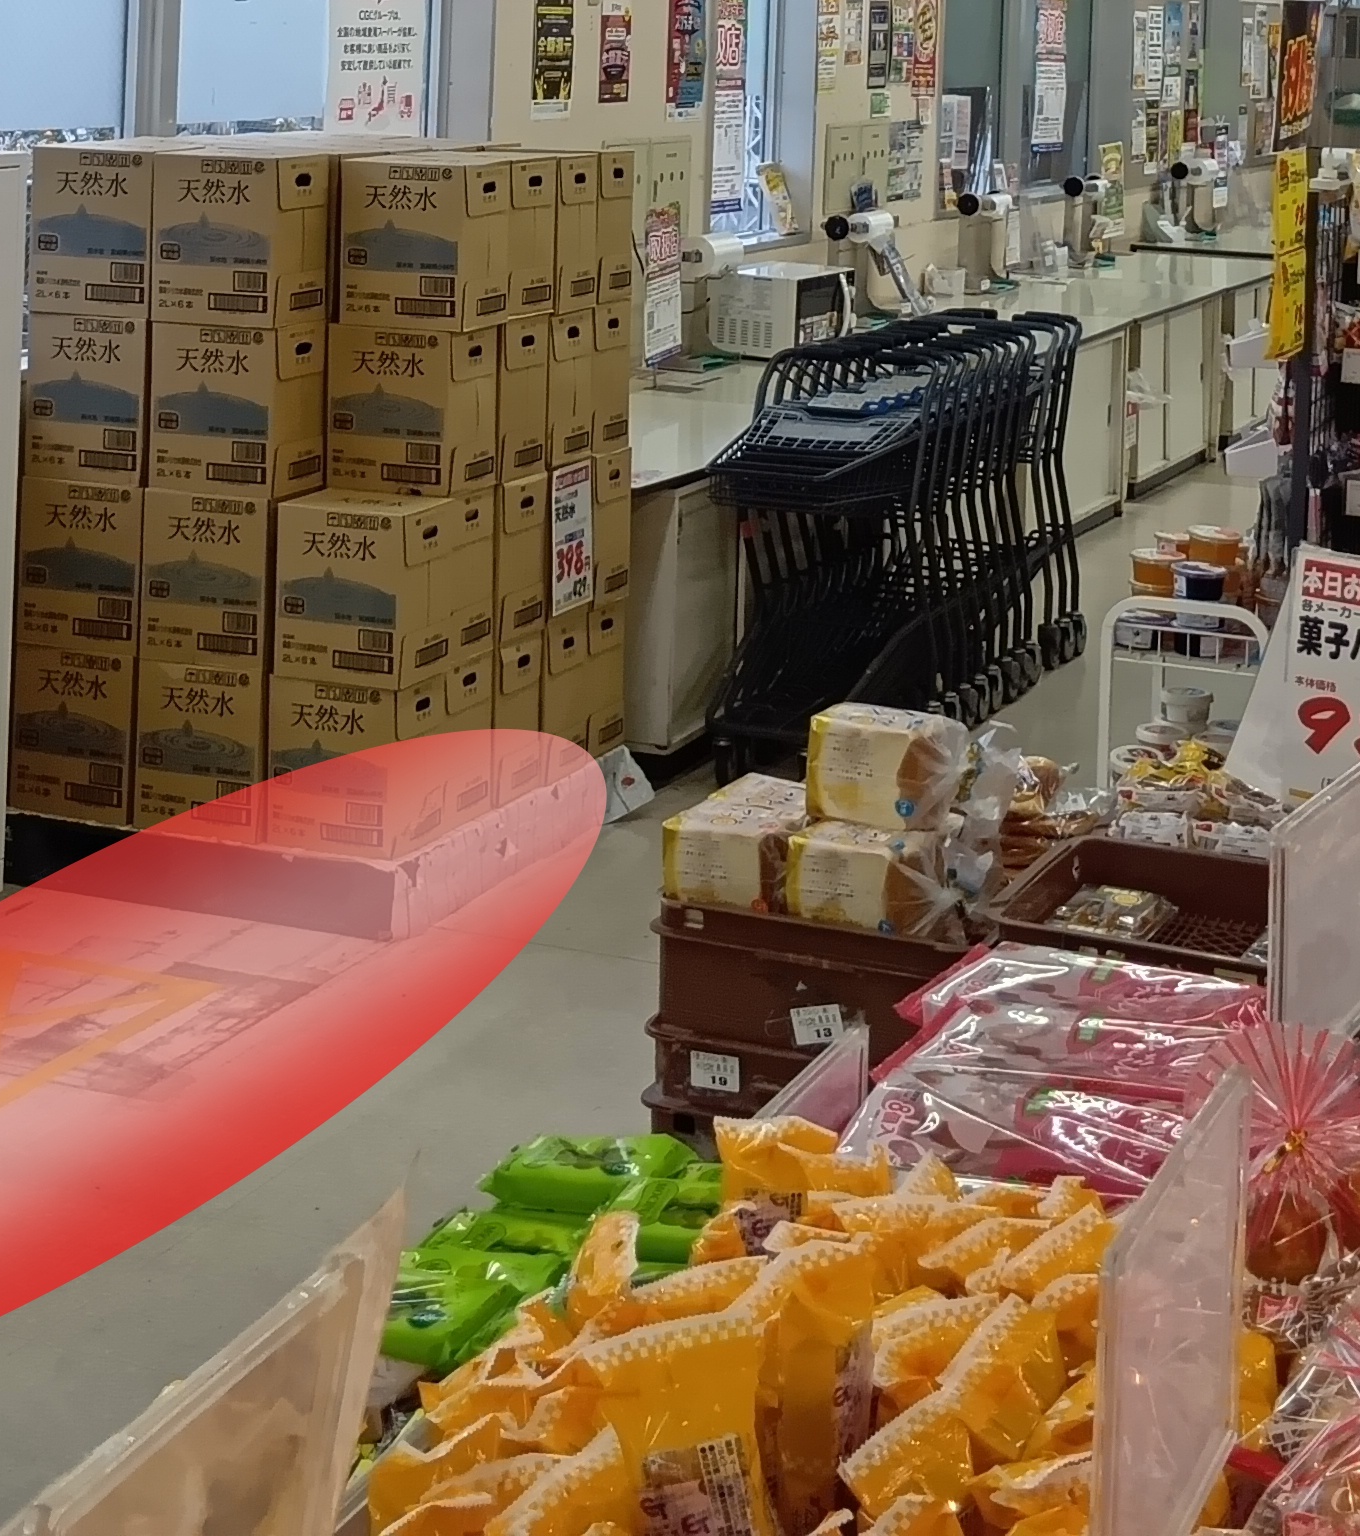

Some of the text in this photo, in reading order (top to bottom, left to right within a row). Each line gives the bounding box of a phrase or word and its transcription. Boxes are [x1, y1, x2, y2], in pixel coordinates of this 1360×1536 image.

[56, 171, 128, 198] 天然水
[177, 178, 250, 205] 天然水
[365, 185, 437, 211] 天然水
[52, 336, 121, 364] 天然水
[176, 348, 250, 375] 天然水
[352, 351, 425, 377] 天然水
[44, 503, 117, 532] 天然水
[167, 516, 241, 545] 天然水
[302, 531, 376, 561] 天然水
[38, 668, 107, 700] 天然水
[1294, 675, 1337, 692] 本体価格
[160, 687, 234, 717] 天然水
[290, 703, 365, 735] 天然水
[814, 1027, 832, 1039] 13
[710, 1075, 728, 1086] 19
